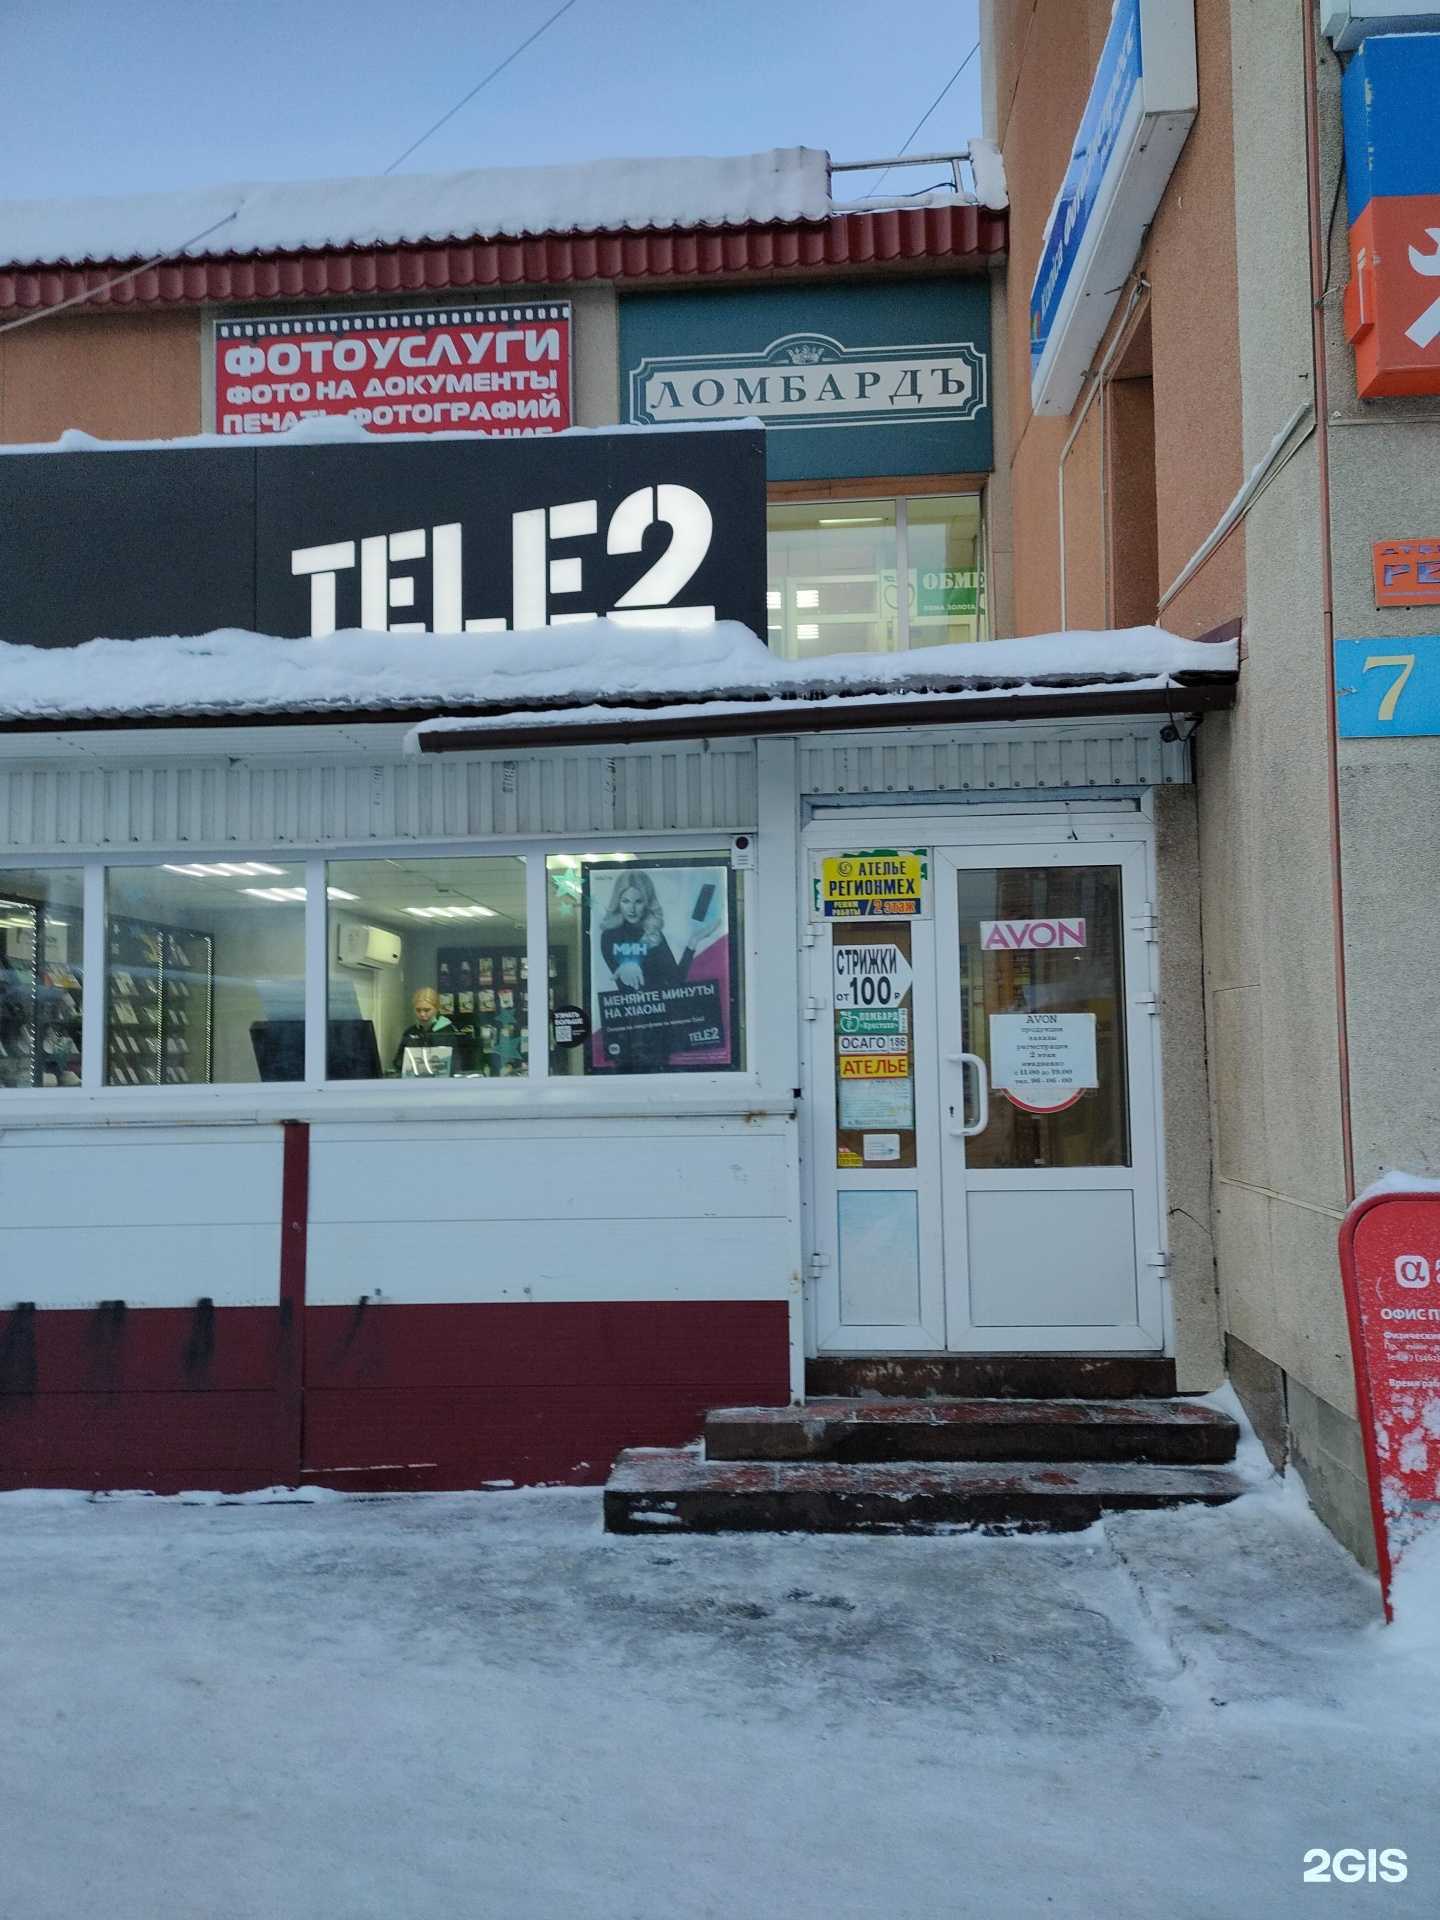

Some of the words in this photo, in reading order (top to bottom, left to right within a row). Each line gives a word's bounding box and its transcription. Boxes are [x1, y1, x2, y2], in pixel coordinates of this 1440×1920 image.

[224, 329, 560, 377] ФОТОУСЛУГИ
[226, 381, 311, 405] ФОТО
[316, 379, 357, 400] НА
[363, 370, 558, 398] ДОКУМЕНТЫ
[650, 367, 966, 409] ЛОМБАРДЪ
[291, 483, 716, 638] TELE2
[1363, 654, 1416, 721] 7
[858, 861, 907, 876] АТЕЛЬЕ
[829, 878, 915, 896] РЕГИОНМЕХ
[985, 920, 1085, 948] AVON
[836, 949, 897, 975] СТРИЖКИ
[603, 991, 660, 1006] МЕНЯЙТЕ
[662, 984, 715, 1001] МИНУТЫ
[850, 976, 892, 1005] 100
[604, 1008, 622, 1019] НА
[624, 1003, 666, 1017] XIAOMI
[1025, 1015, 1057, 1023] AVON
[689, 1028, 720, 1042] TELE2
[841, 1037, 886, 1049] ОСАГО
[843, 1058, 906, 1075] АТЕЛЬЕ
[1381, 1308, 1426, 1320] ОФИС
